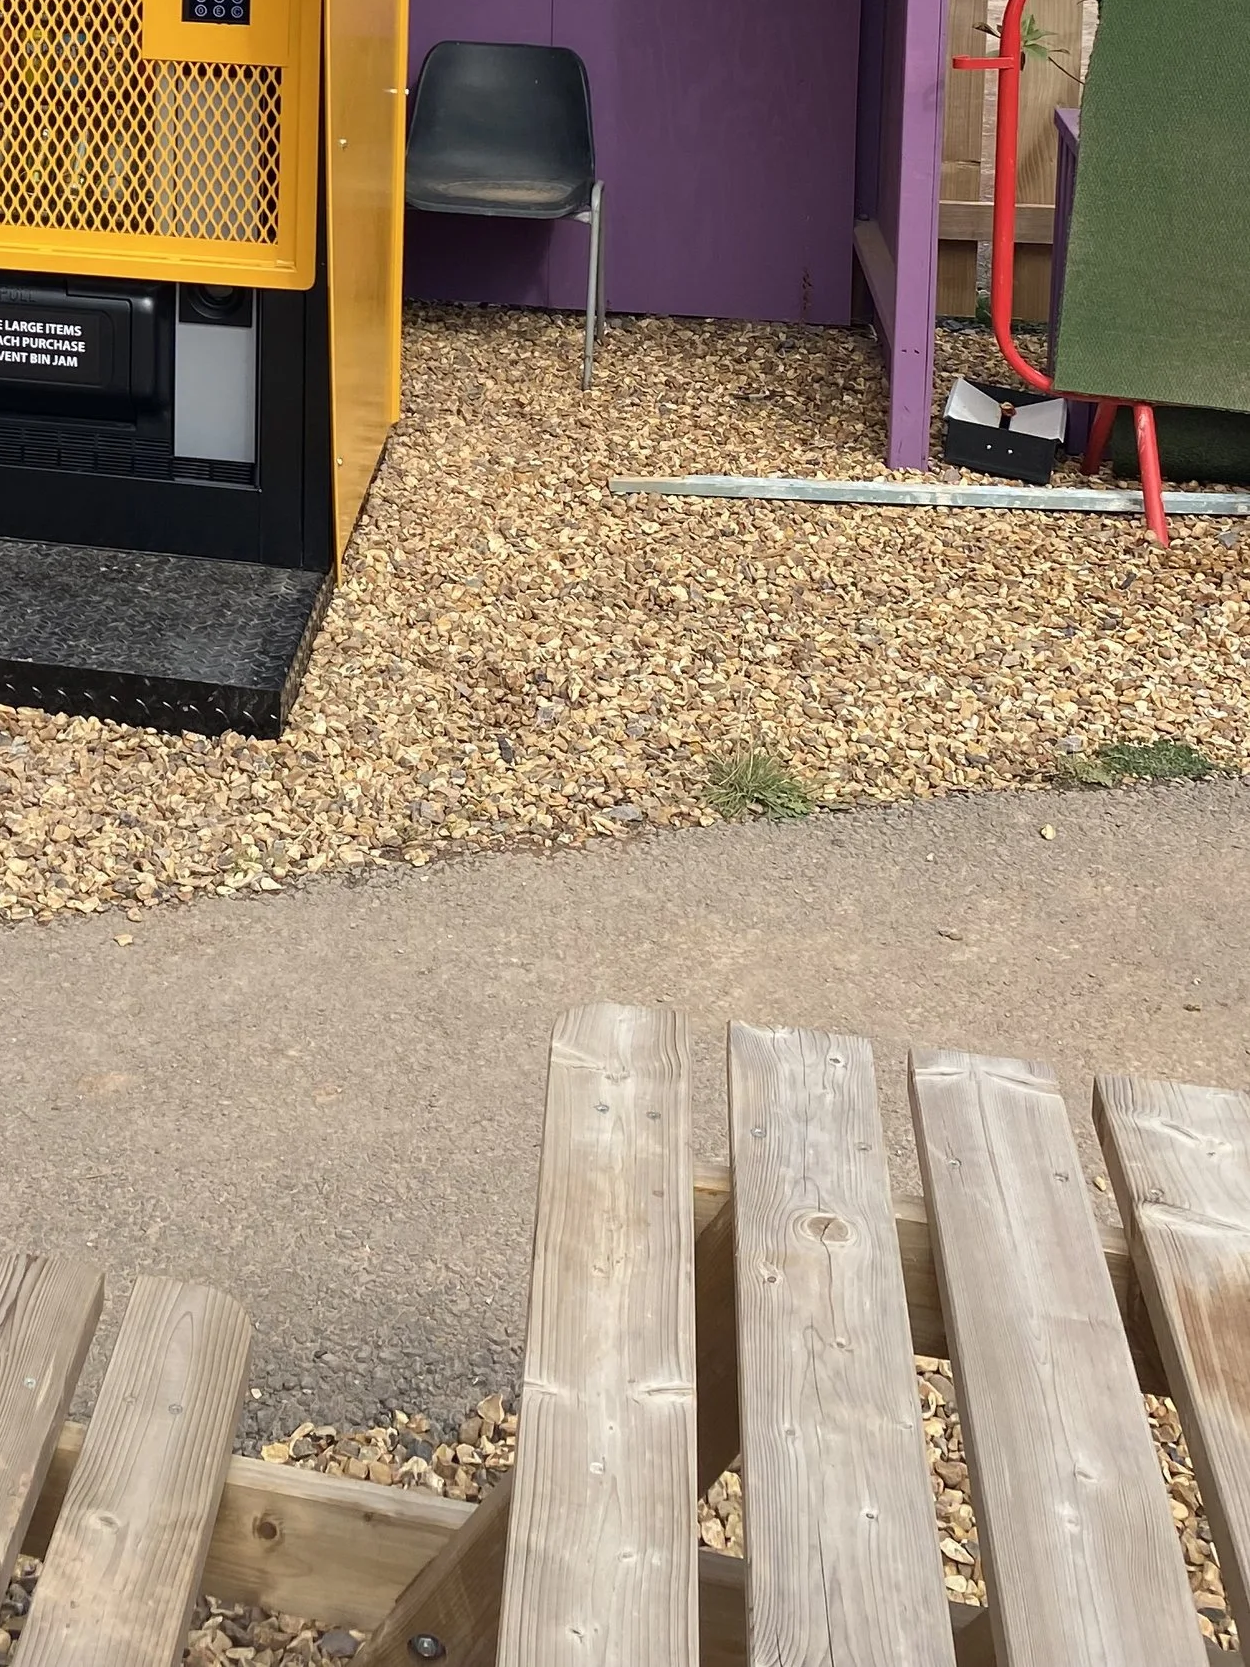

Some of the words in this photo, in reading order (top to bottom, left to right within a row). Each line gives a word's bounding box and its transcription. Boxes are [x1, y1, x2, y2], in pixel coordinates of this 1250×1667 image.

[4, 320, 43, 333] LARGE
[46, 324, 82, 336] ITEMS
[23, 338, 86, 352] PURCHASE
[30, 354, 50, 364] BIN
[52, 356, 78, 367] JAM
